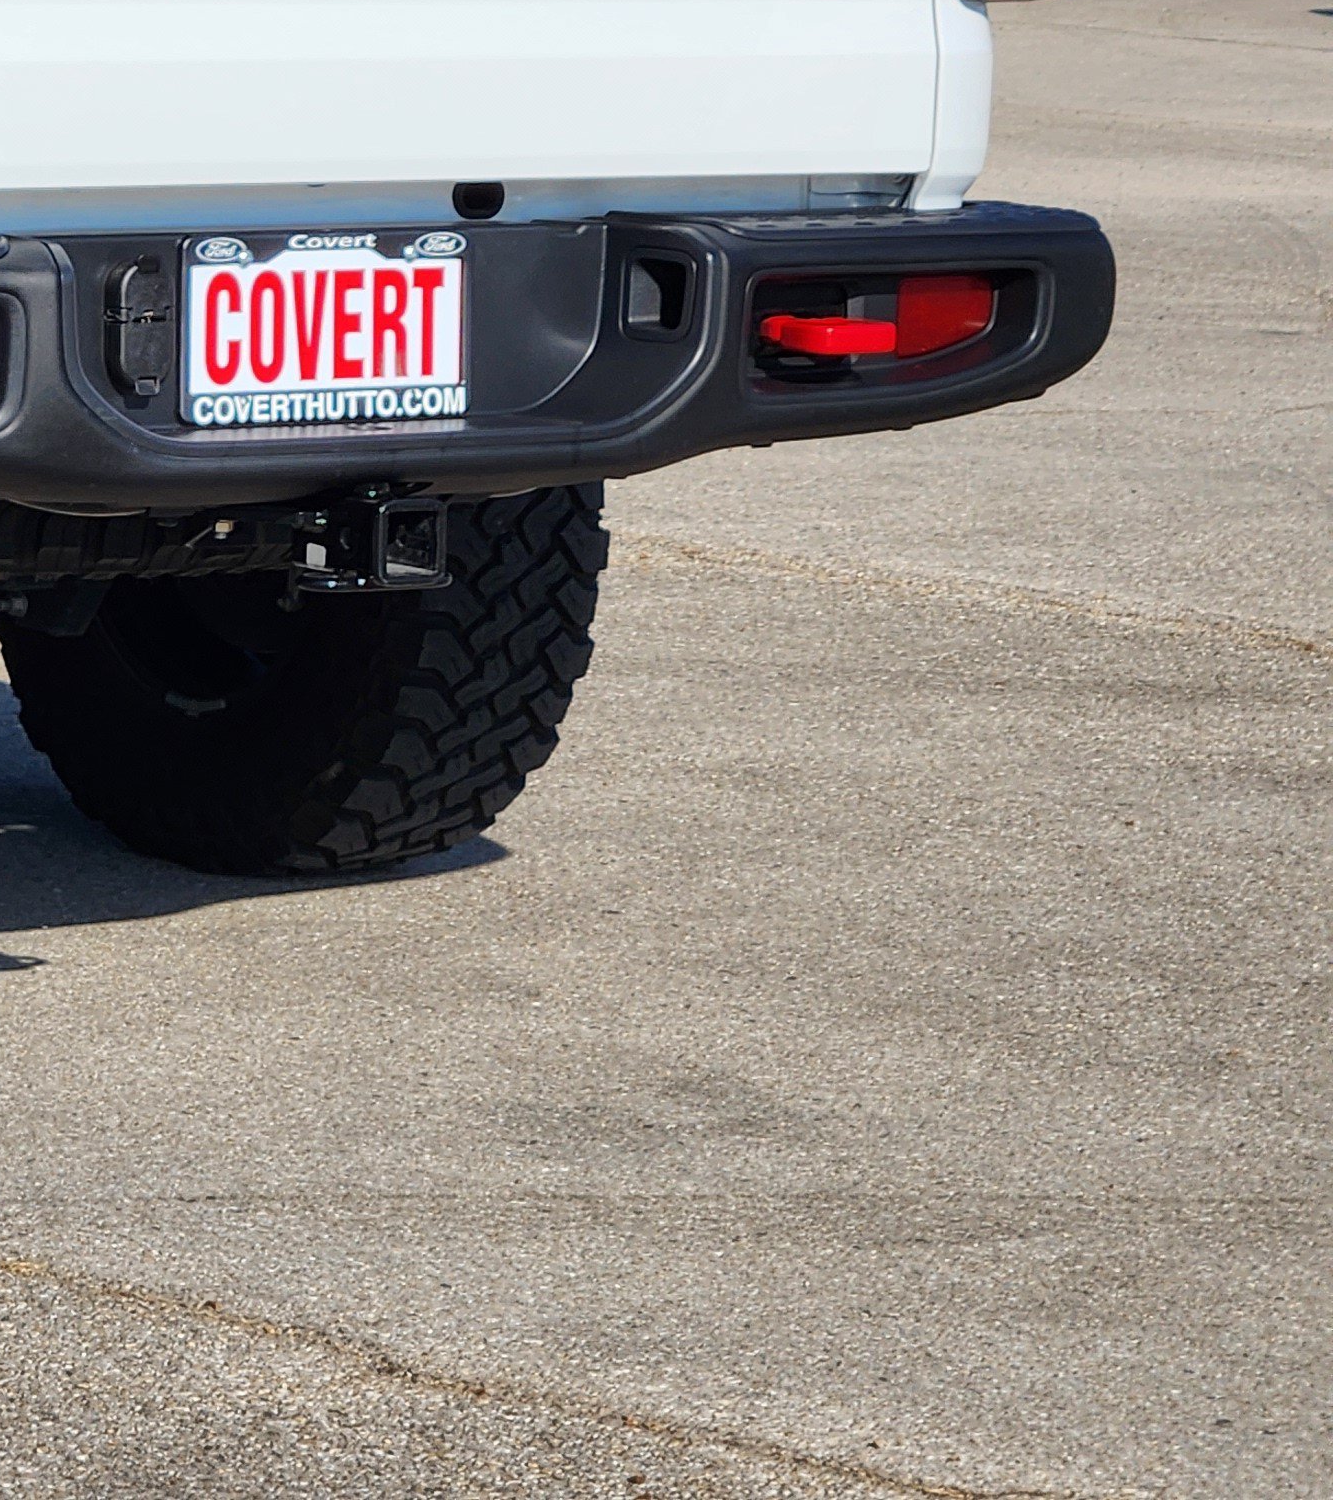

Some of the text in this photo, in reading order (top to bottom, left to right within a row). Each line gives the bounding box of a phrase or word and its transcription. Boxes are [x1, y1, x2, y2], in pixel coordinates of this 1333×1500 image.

[288, 233, 378, 250] Covert
[205, 265, 446, 386] COVERT
[192, 386, 468, 426] COVERTHUTTO.COM
